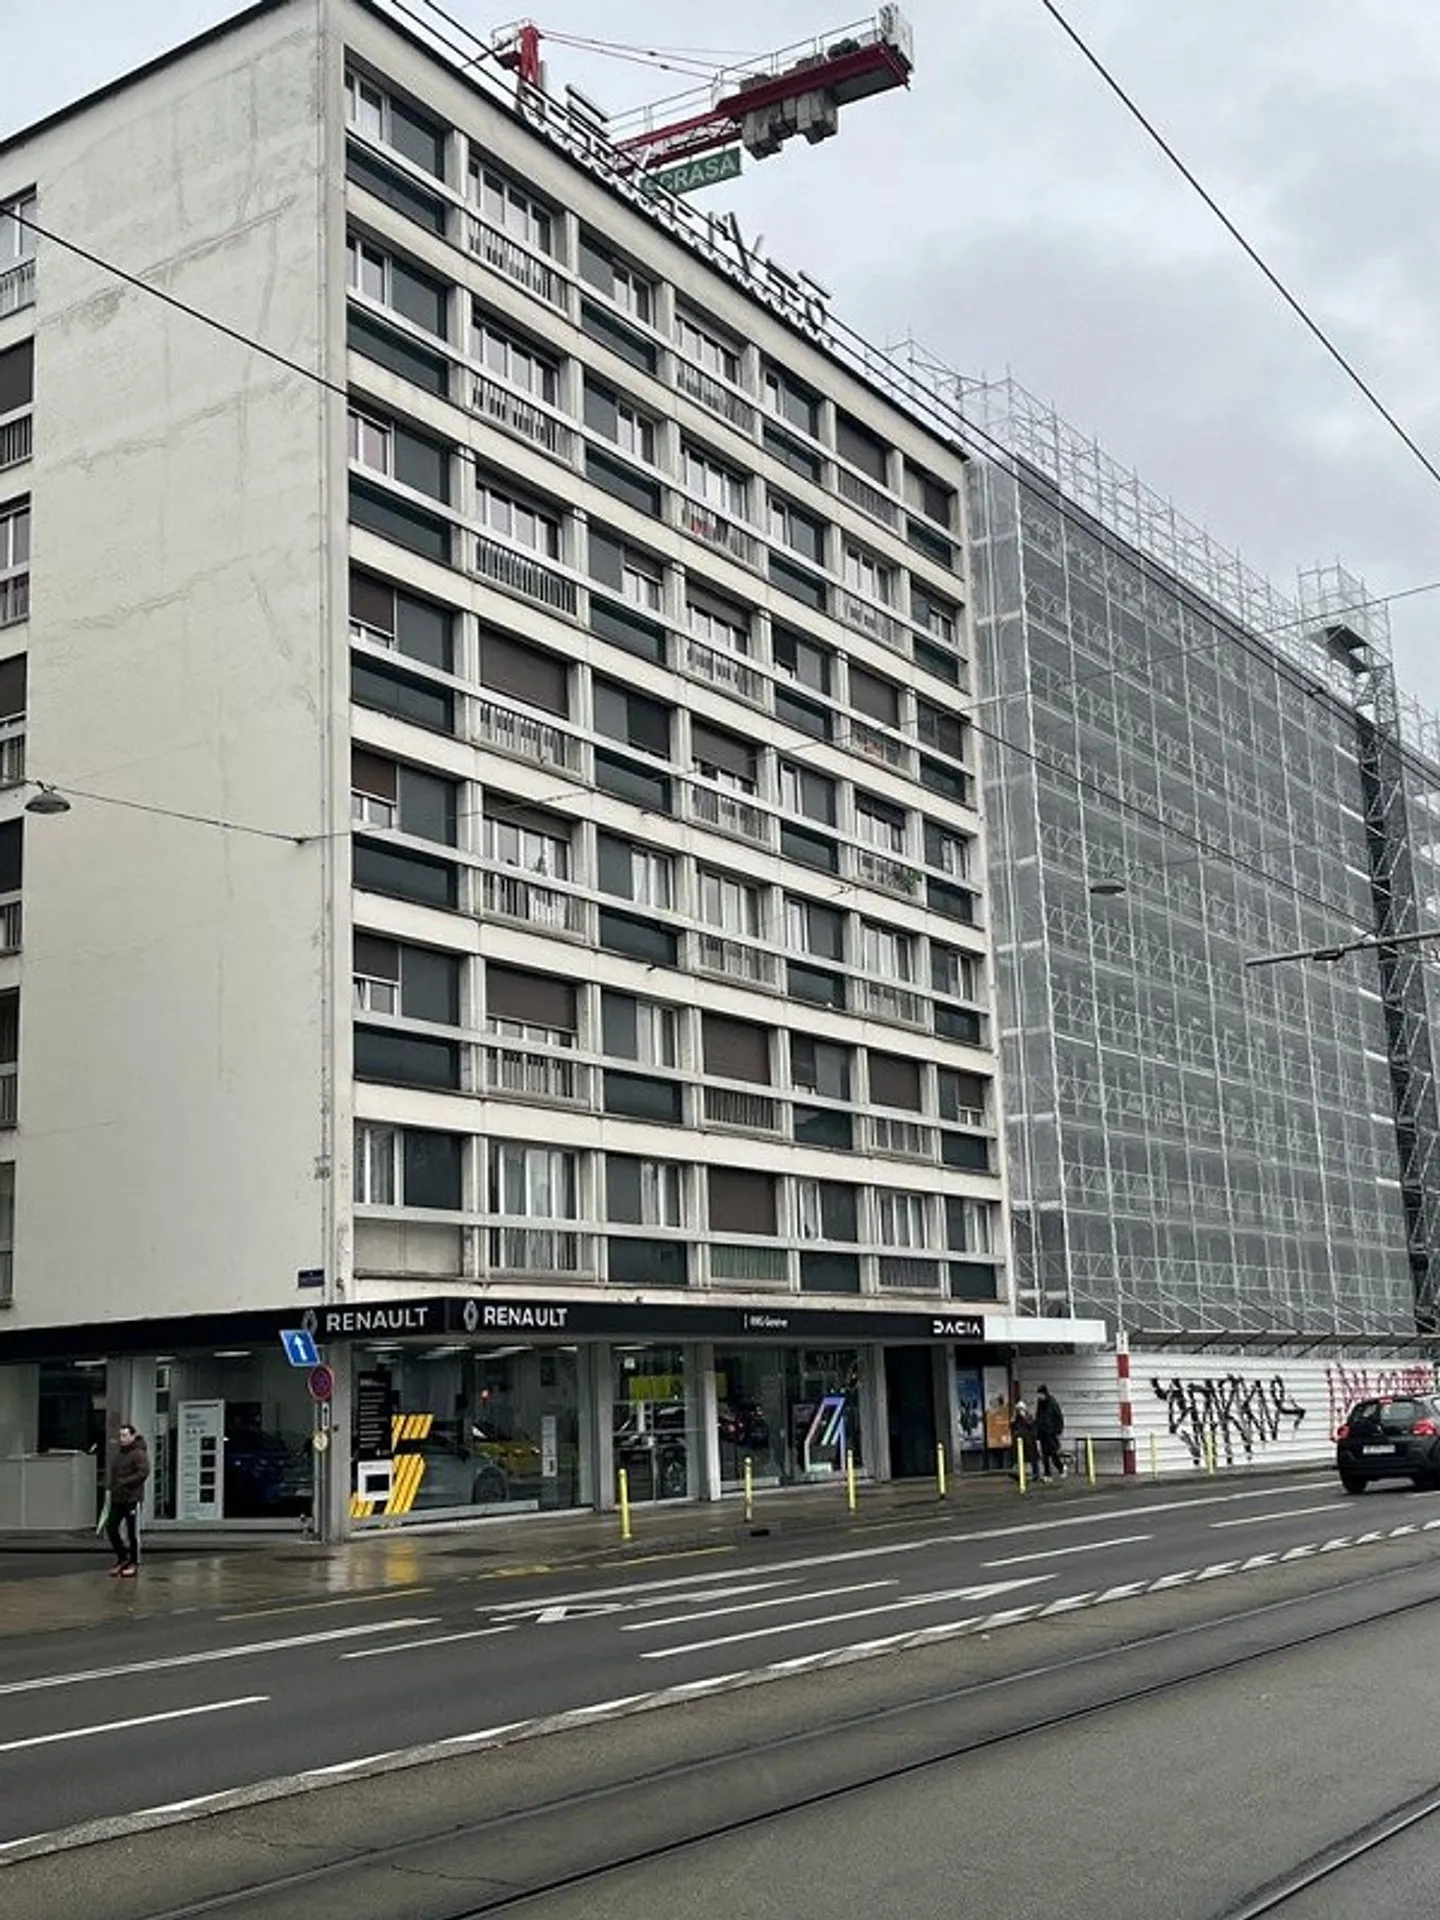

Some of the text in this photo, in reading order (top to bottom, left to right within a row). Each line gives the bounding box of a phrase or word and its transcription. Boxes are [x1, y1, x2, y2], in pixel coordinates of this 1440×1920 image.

[326, 1307, 428, 1332] RENAULT
[484, 1306, 568, 1327] RENAULT
[933, 1320, 981, 1335] DACIA
